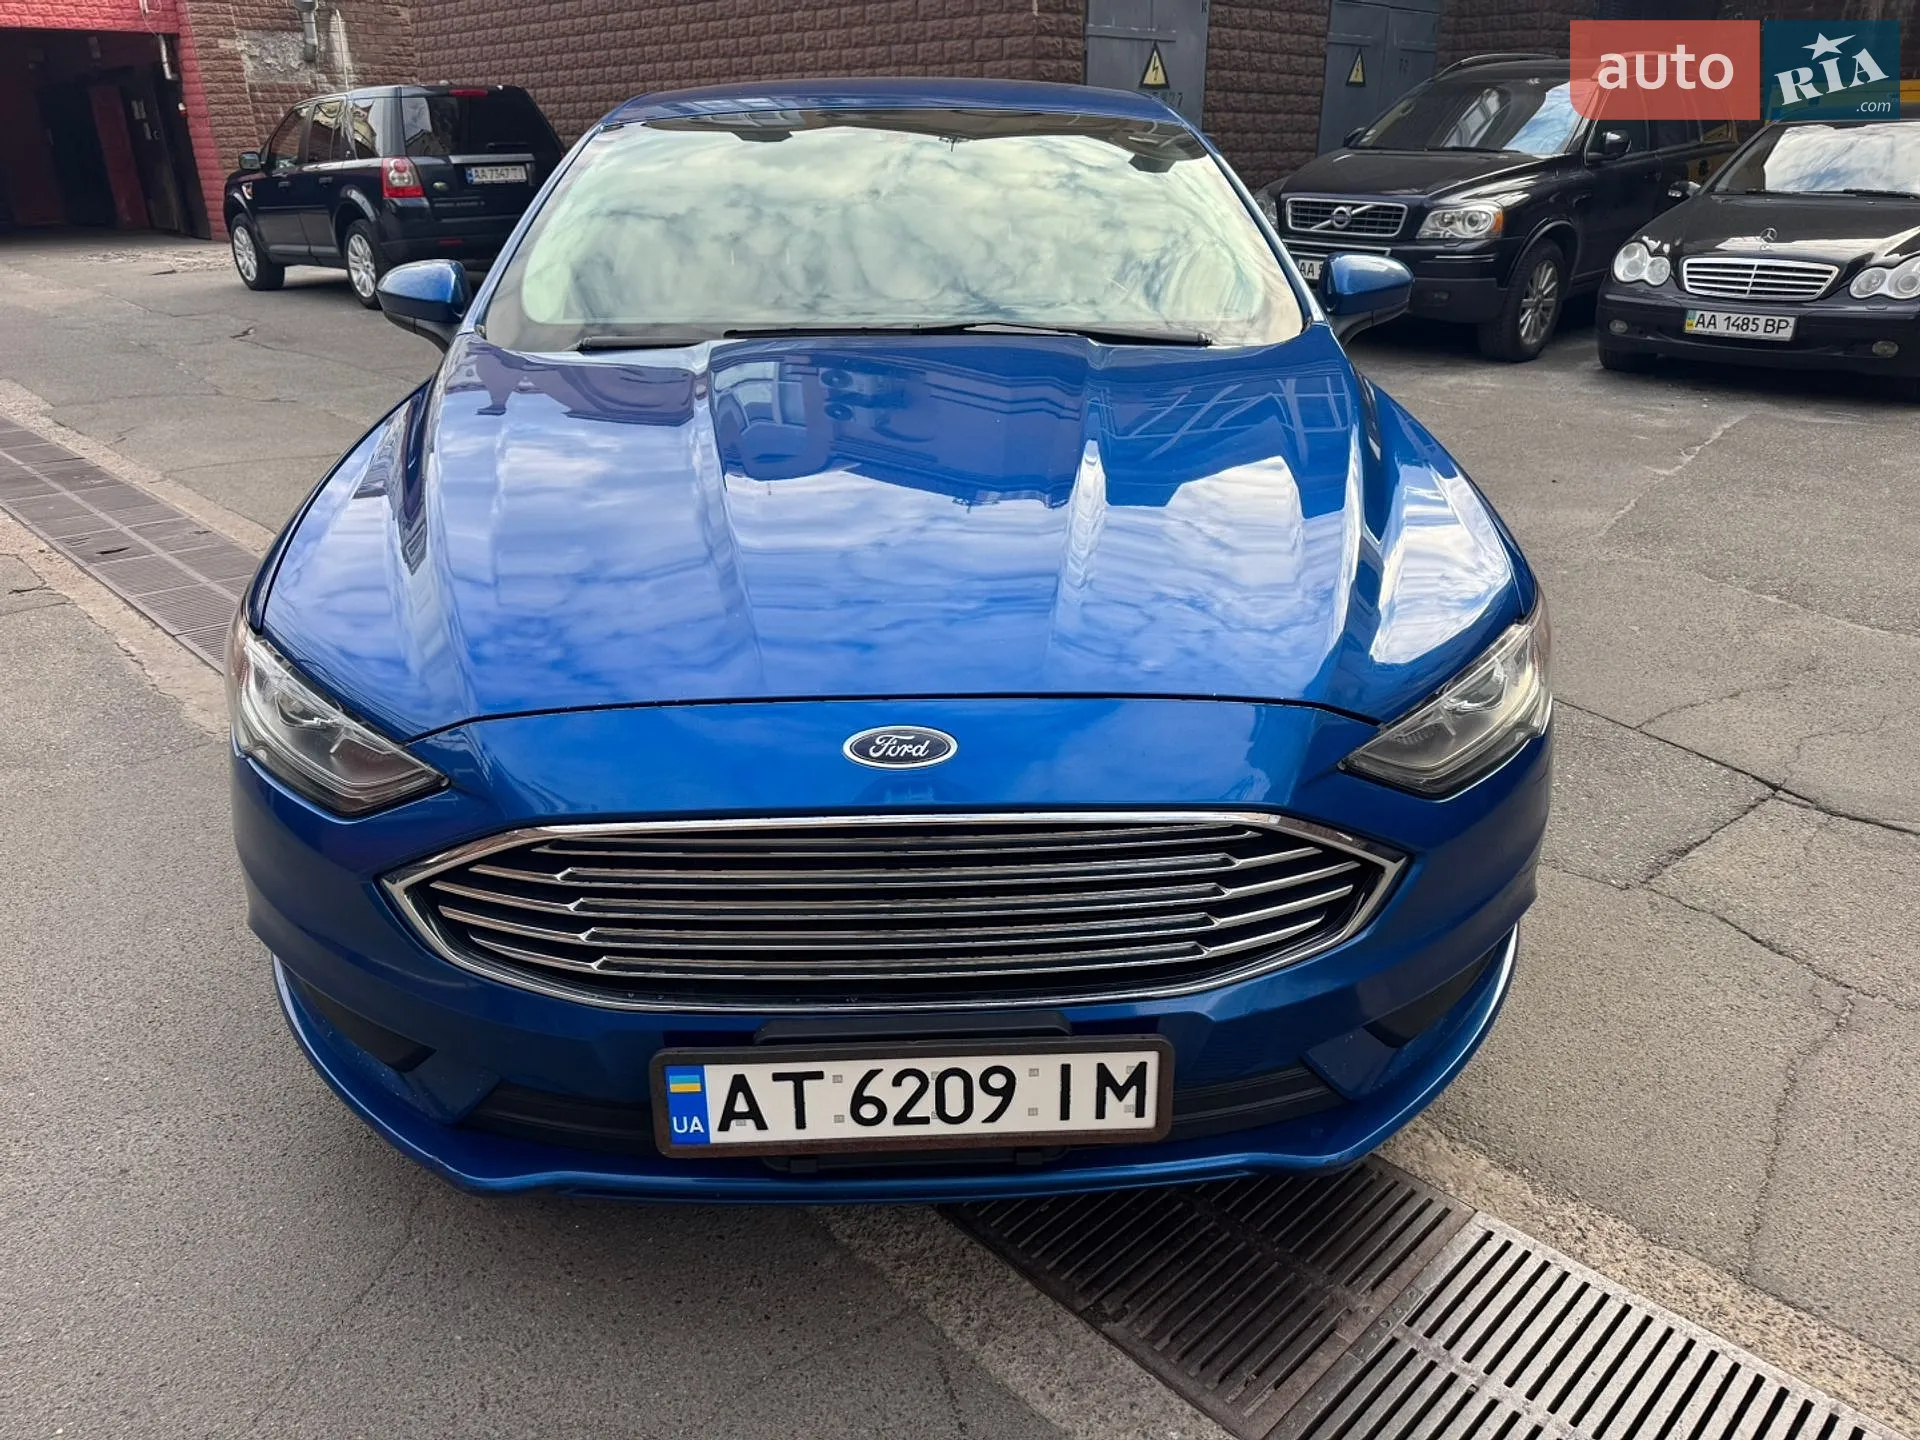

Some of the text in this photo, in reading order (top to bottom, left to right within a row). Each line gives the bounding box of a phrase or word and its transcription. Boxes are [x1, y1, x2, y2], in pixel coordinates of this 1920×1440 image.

[1299, 262, 1315, 277] AA
[1695, 313, 1790, 334] AA 1485 BP
[869, 734, 931, 758] Ford
[718, 1061, 1148, 1132] AT 6209 IM
[672, 1115, 705, 1134] UA
